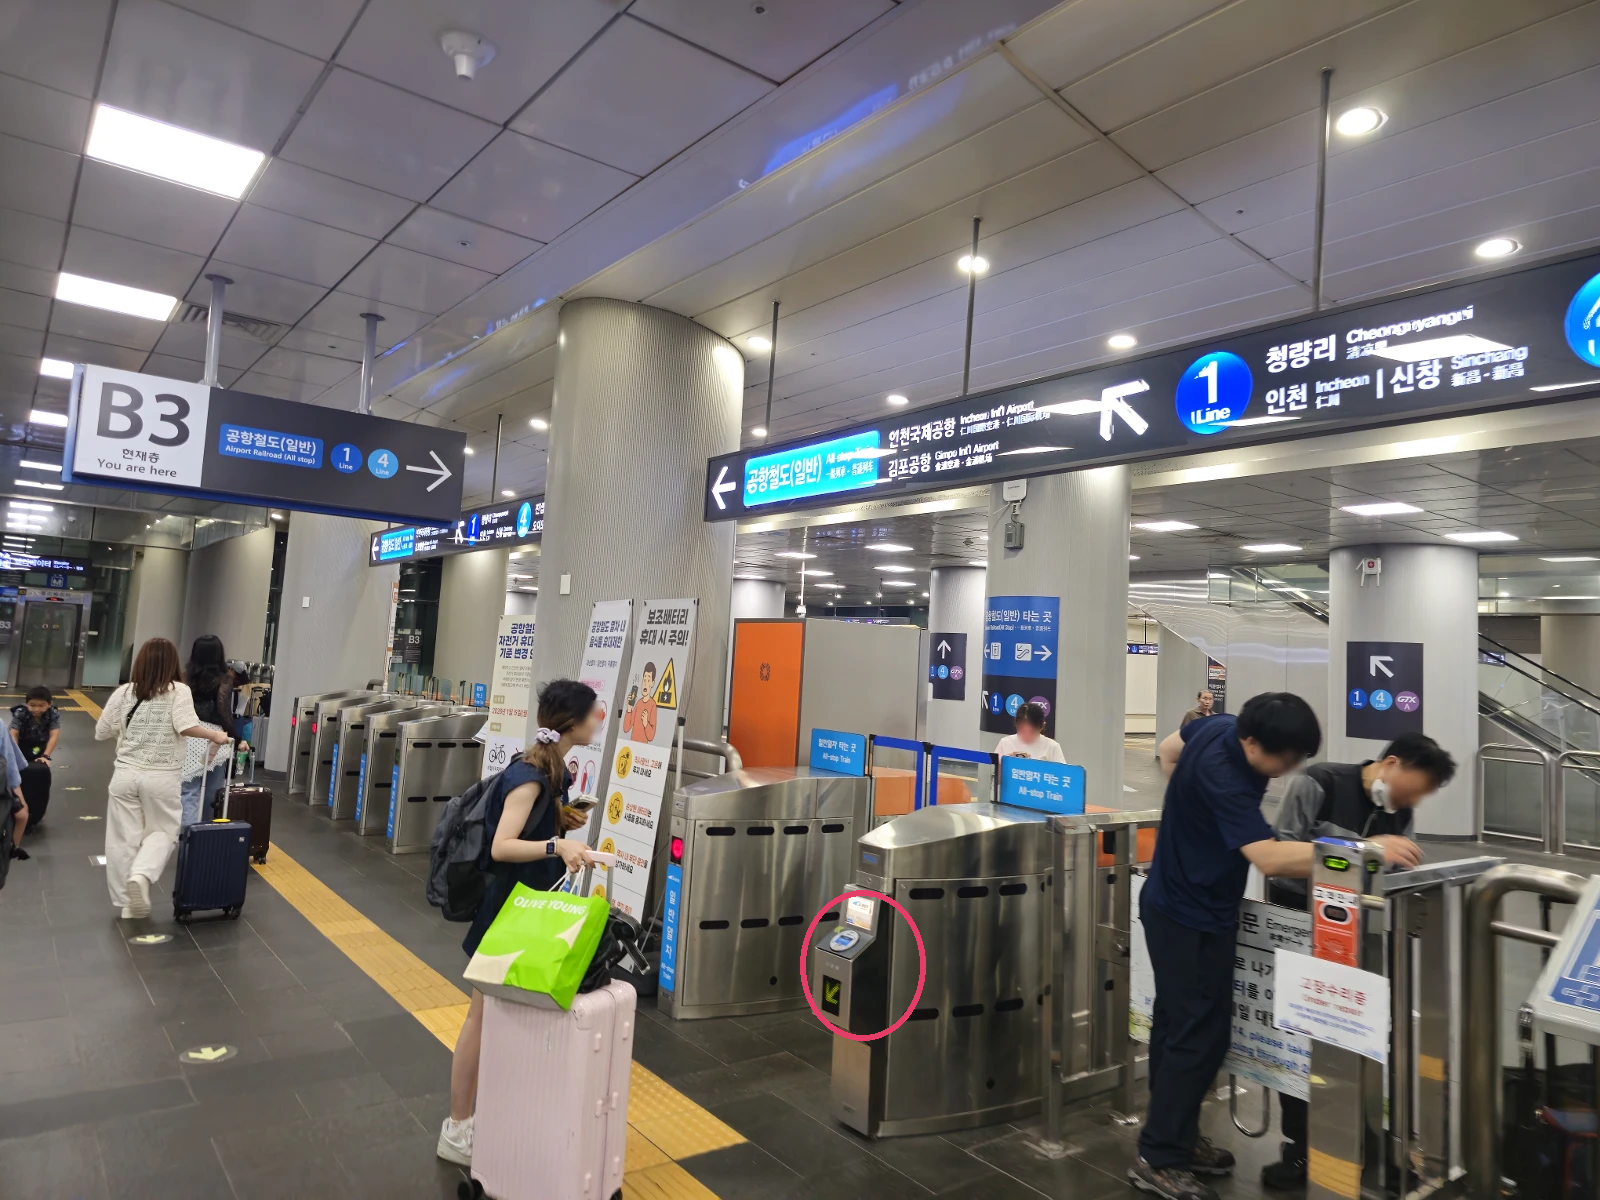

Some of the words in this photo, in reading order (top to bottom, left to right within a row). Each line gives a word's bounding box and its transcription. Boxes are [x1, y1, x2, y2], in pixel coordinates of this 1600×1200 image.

[1265, 333, 1337, 373] 청량리
[1451, 346, 1529, 371] Sinchang
[1194, 360, 1218, 404] 1
[1315, 374, 1370, 394] Incheon
[1390, 359, 1443, 394] 신창
[1264, 382, 1308, 414] 인천
[96, 382, 190, 447] B3
[960, 411, 989, 425] Incheon
[1006, 400, 1035, 416] Airport
[888, 417, 957, 448] 인천국제공항
[226, 429, 317, 456] 공항철도(일반)
[935, 449, 958, 461] Gimpo
[973, 441, 999, 454] Airport
[122, 448, 160, 463] 현재층
[225, 444, 252, 455] Airport
[253, 449, 283, 459] Railroad
[297, 456, 316, 465] stop)
[343, 447, 351, 462] 1
[377, 453, 389, 468] 4
[97, 458, 121, 470] You
[126, 464, 146, 473] are
[150, 465, 177, 477] here
[339, 462, 353, 471] Line
[375, 467, 390, 476] Line
[746, 453, 822, 494] 공항철도(일반)
[888, 452, 931, 477] 김포공항
[472, 516, 477, 534] 1
[520, 506, 528, 526] 4
[647, 609, 689, 625] 보조배터리
[1023, 610, 1040, 622] 타는
[1042, 611, 1052, 622] 곳
[592, 620, 610, 633] 공항철도
[610, 620, 619, 632] 열차
[408, 635, 420, 644] B3
[499, 635, 519, 646] 자전거
[640, 629, 657, 645] 휴대
[658, 630, 667, 646] 시
[668, 630, 689, 646] 주의!
[500, 647, 512, 658] 기준
[514, 648, 528, 659] 변경
[940, 666, 945, 675] 4
[993, 695, 998, 707] 1
[1010, 697, 1018, 709] 4
[1354, 691, 1360, 702] 1
[1375, 692, 1385, 703] 4
[1397, 695, 1417, 704] GTX
[818, 738, 837, 750] 일반열차
[839, 741, 849, 752] 타는
[850, 743, 857, 753] 곳
[1011, 768, 1041, 783] 일반열차
[1043, 773, 1059, 786] 타는
[1062, 776, 1072, 788] 곳
[1018, 786, 1044, 799] All-stop
[1045, 790, 1063, 802] Train
[513, 895, 548, 909] OLIVE
[547, 899, 588, 916] YOUNG
[1299, 976, 1367, 1006] 고장수리중
[1249, 1031, 1284, 1050] please
